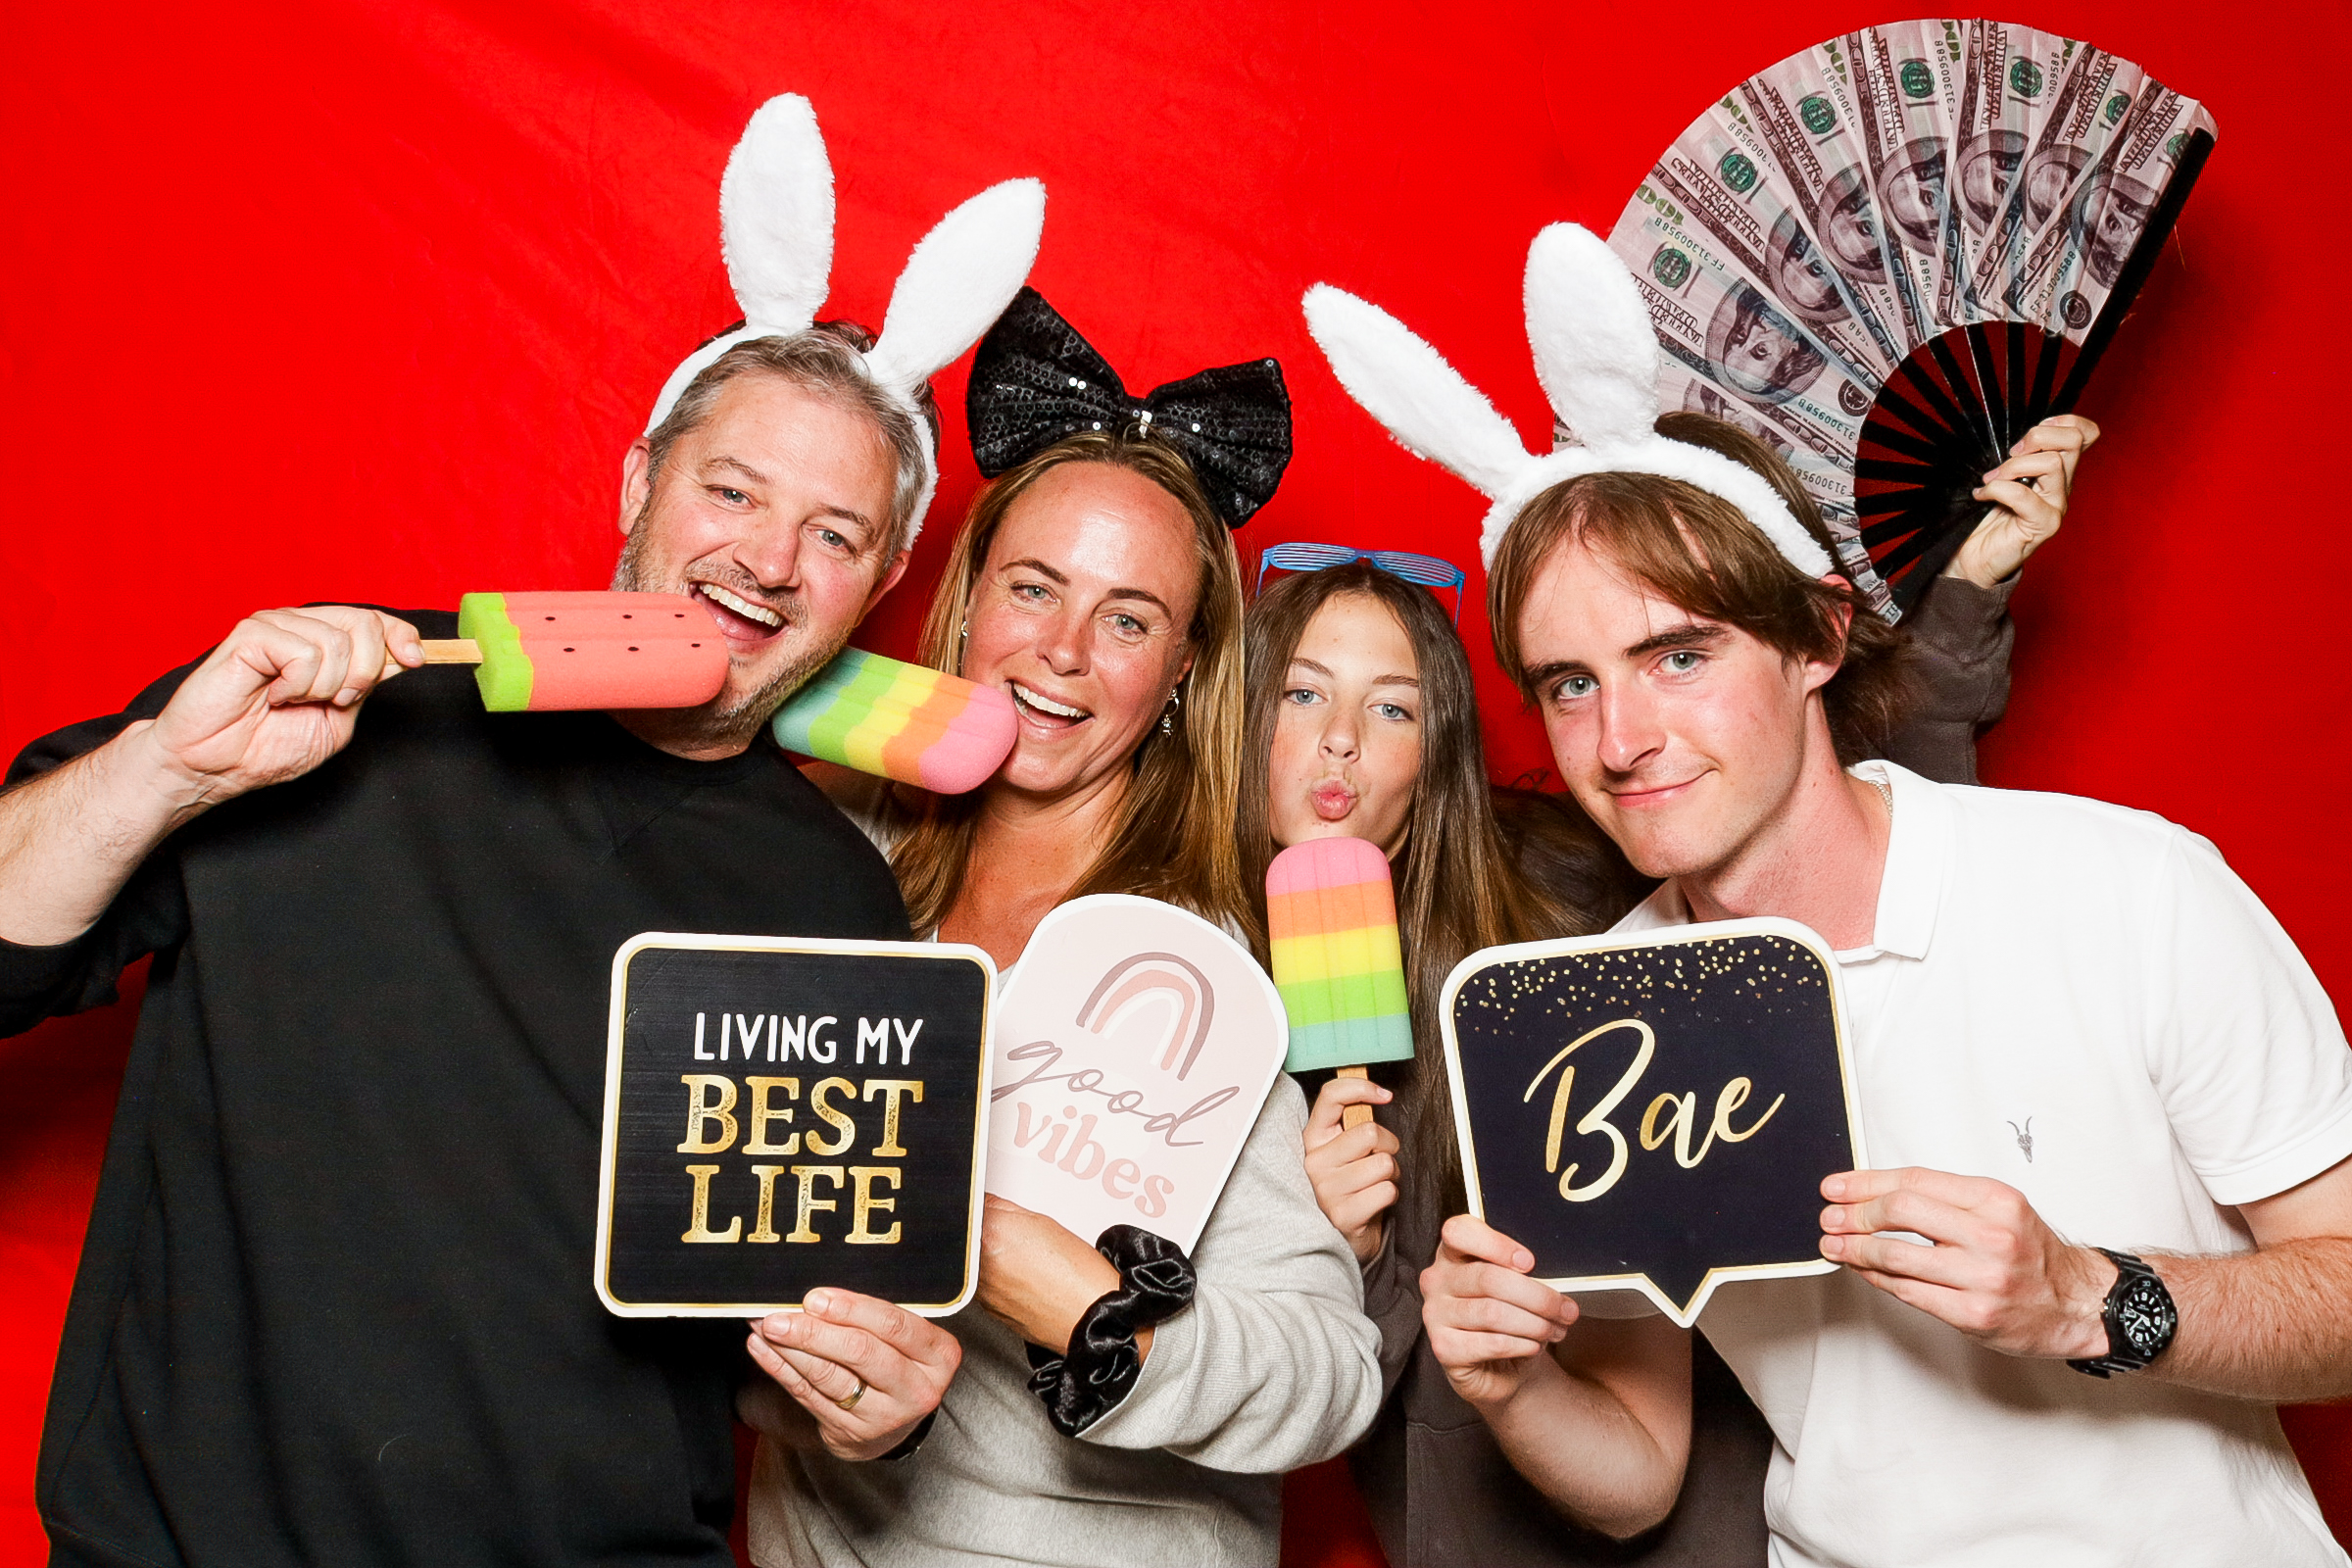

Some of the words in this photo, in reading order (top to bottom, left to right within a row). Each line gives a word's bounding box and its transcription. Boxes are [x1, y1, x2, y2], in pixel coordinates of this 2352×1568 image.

[694, 1012, 838, 1064] LIVING
[856, 1016, 924, 1066] MY
[676, 1074, 924, 1158] BEST
[991, 1040, 1241, 1147] good
[1523, 1018, 1787, 1203] Bae
[681, 1164, 903, 1245] LIFE
[1013, 1102, 1175, 1218] vibes
